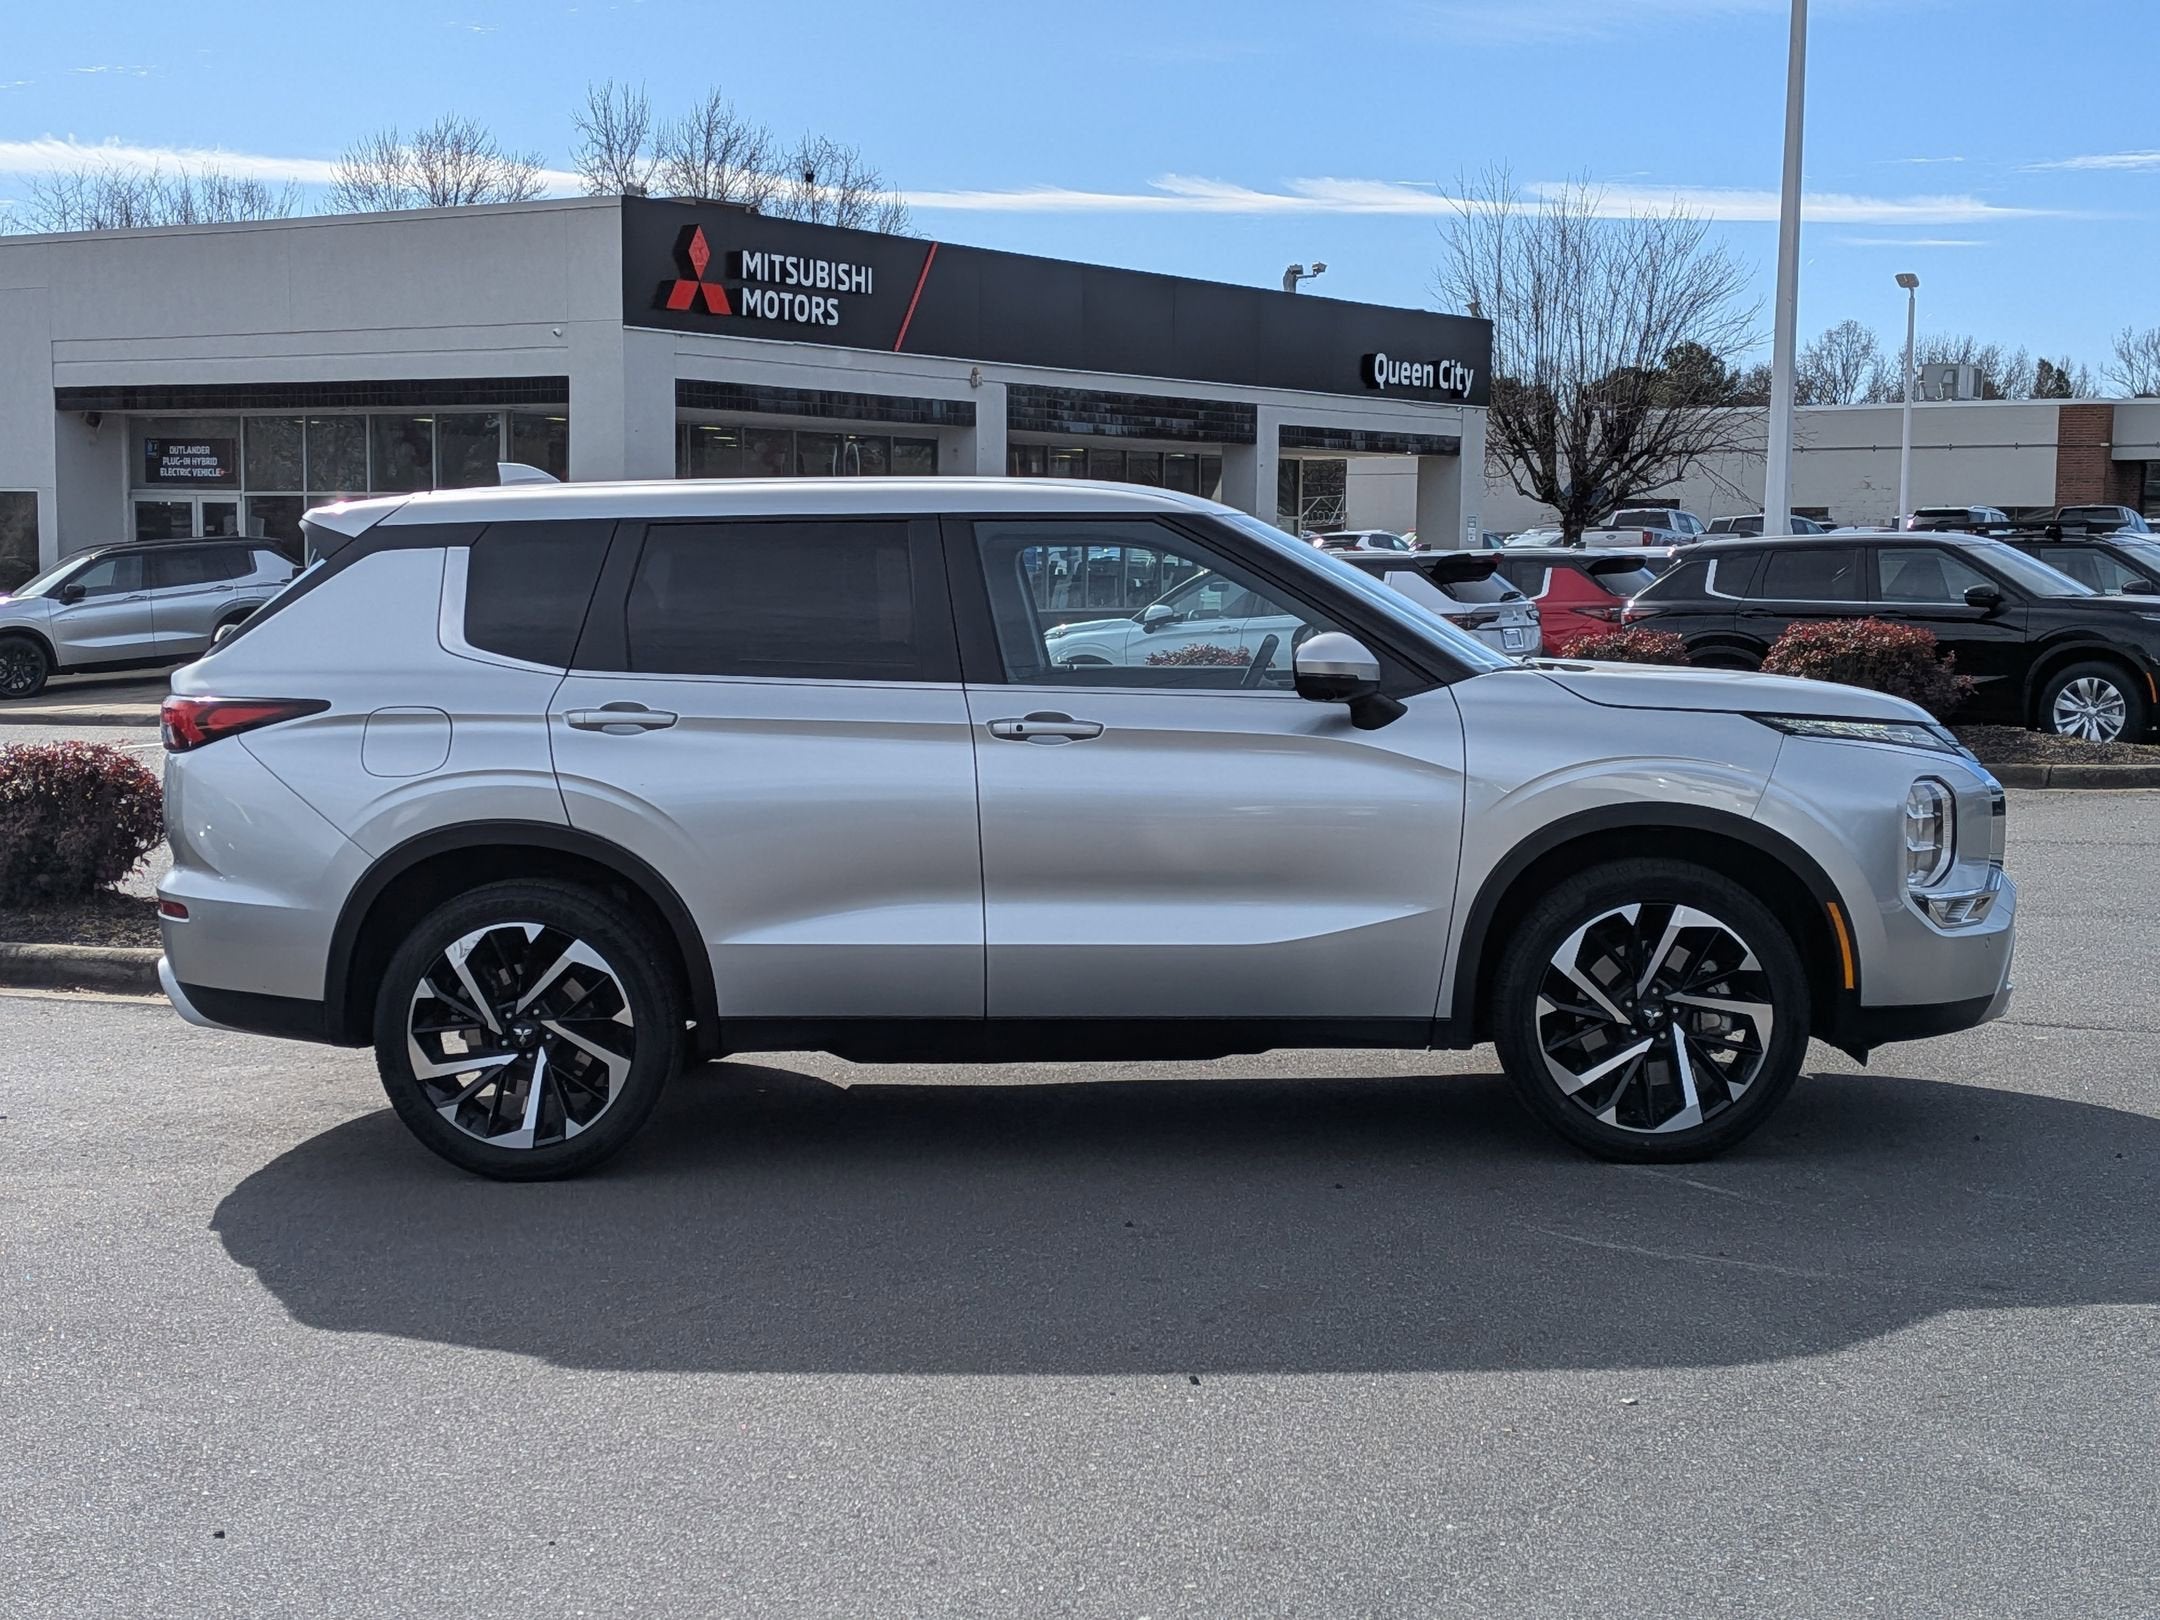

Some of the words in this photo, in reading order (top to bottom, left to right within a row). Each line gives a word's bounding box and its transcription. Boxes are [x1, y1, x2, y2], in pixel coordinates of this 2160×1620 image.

[742, 250, 872, 294] MITSUBISHI
[742, 287, 839, 326] MOTORS
[1374, 352, 1434, 389] Queen
[1439, 359, 1474, 398] City
[162, 456, 191, 466] PLUG-IN
[191, 456, 218, 466] HYBRID
[169, 445, 210, 455] OUTLANDER
[160, 467, 192, 477] ELECTRIC
[192, 467, 221, 477] VEHICLE
